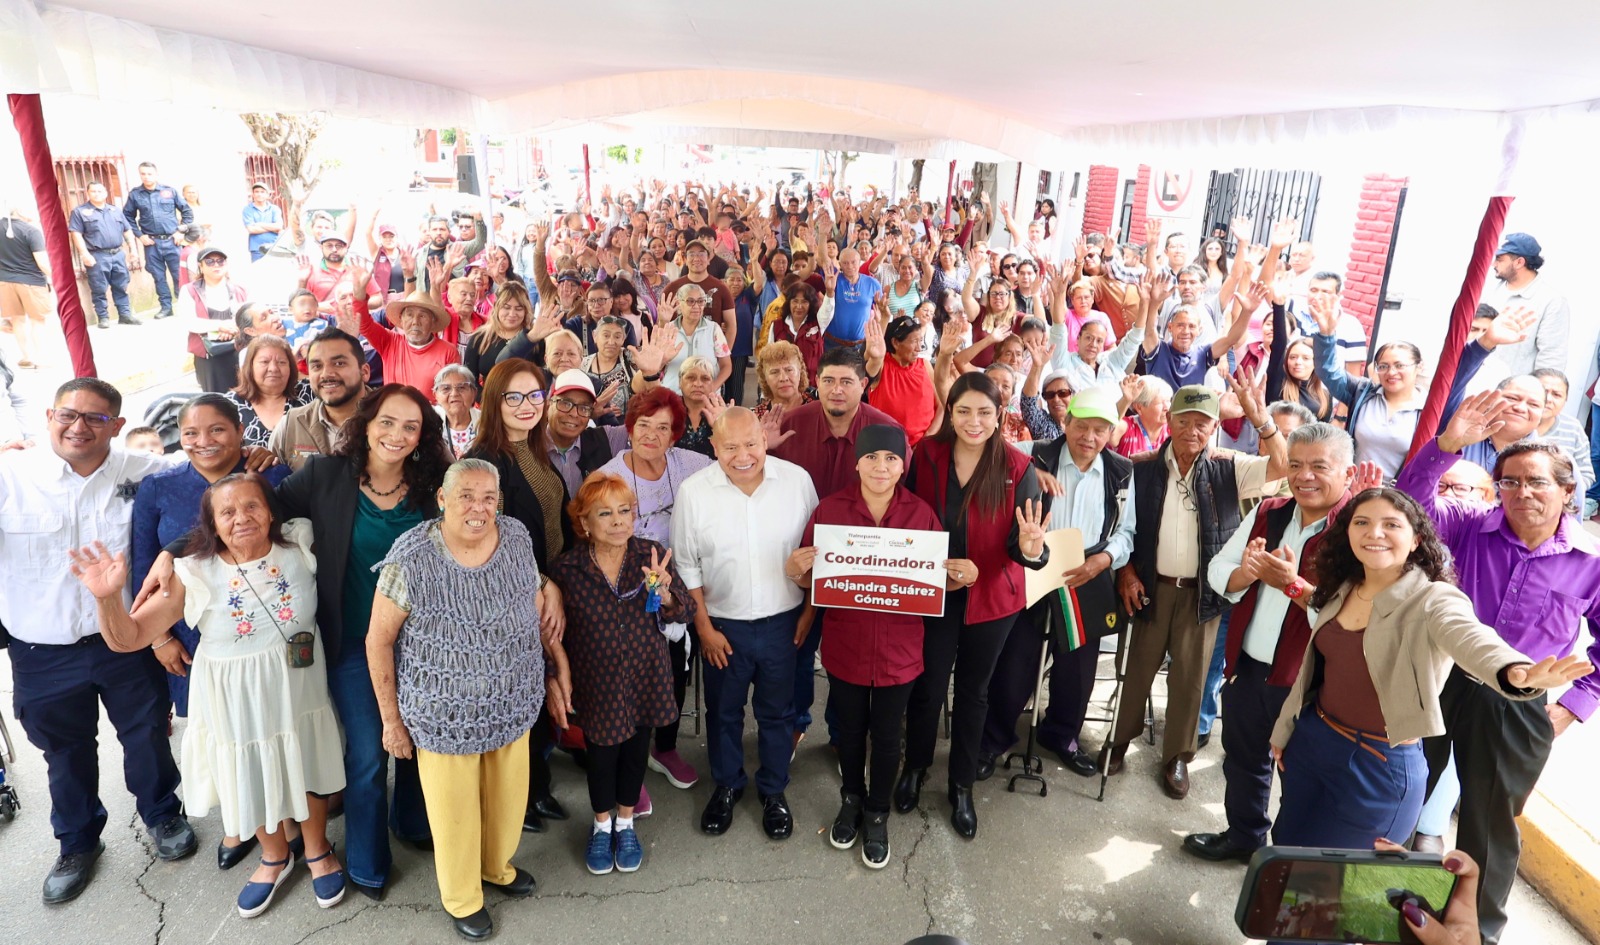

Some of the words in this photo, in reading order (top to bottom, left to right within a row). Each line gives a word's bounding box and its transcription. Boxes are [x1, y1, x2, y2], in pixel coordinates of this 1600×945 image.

[824, 552, 935, 570] Coordinadora
[823, 579, 887, 593] Alejandra
[890, 584, 936, 596] Suárez
[854, 594, 900, 606] Gómez
